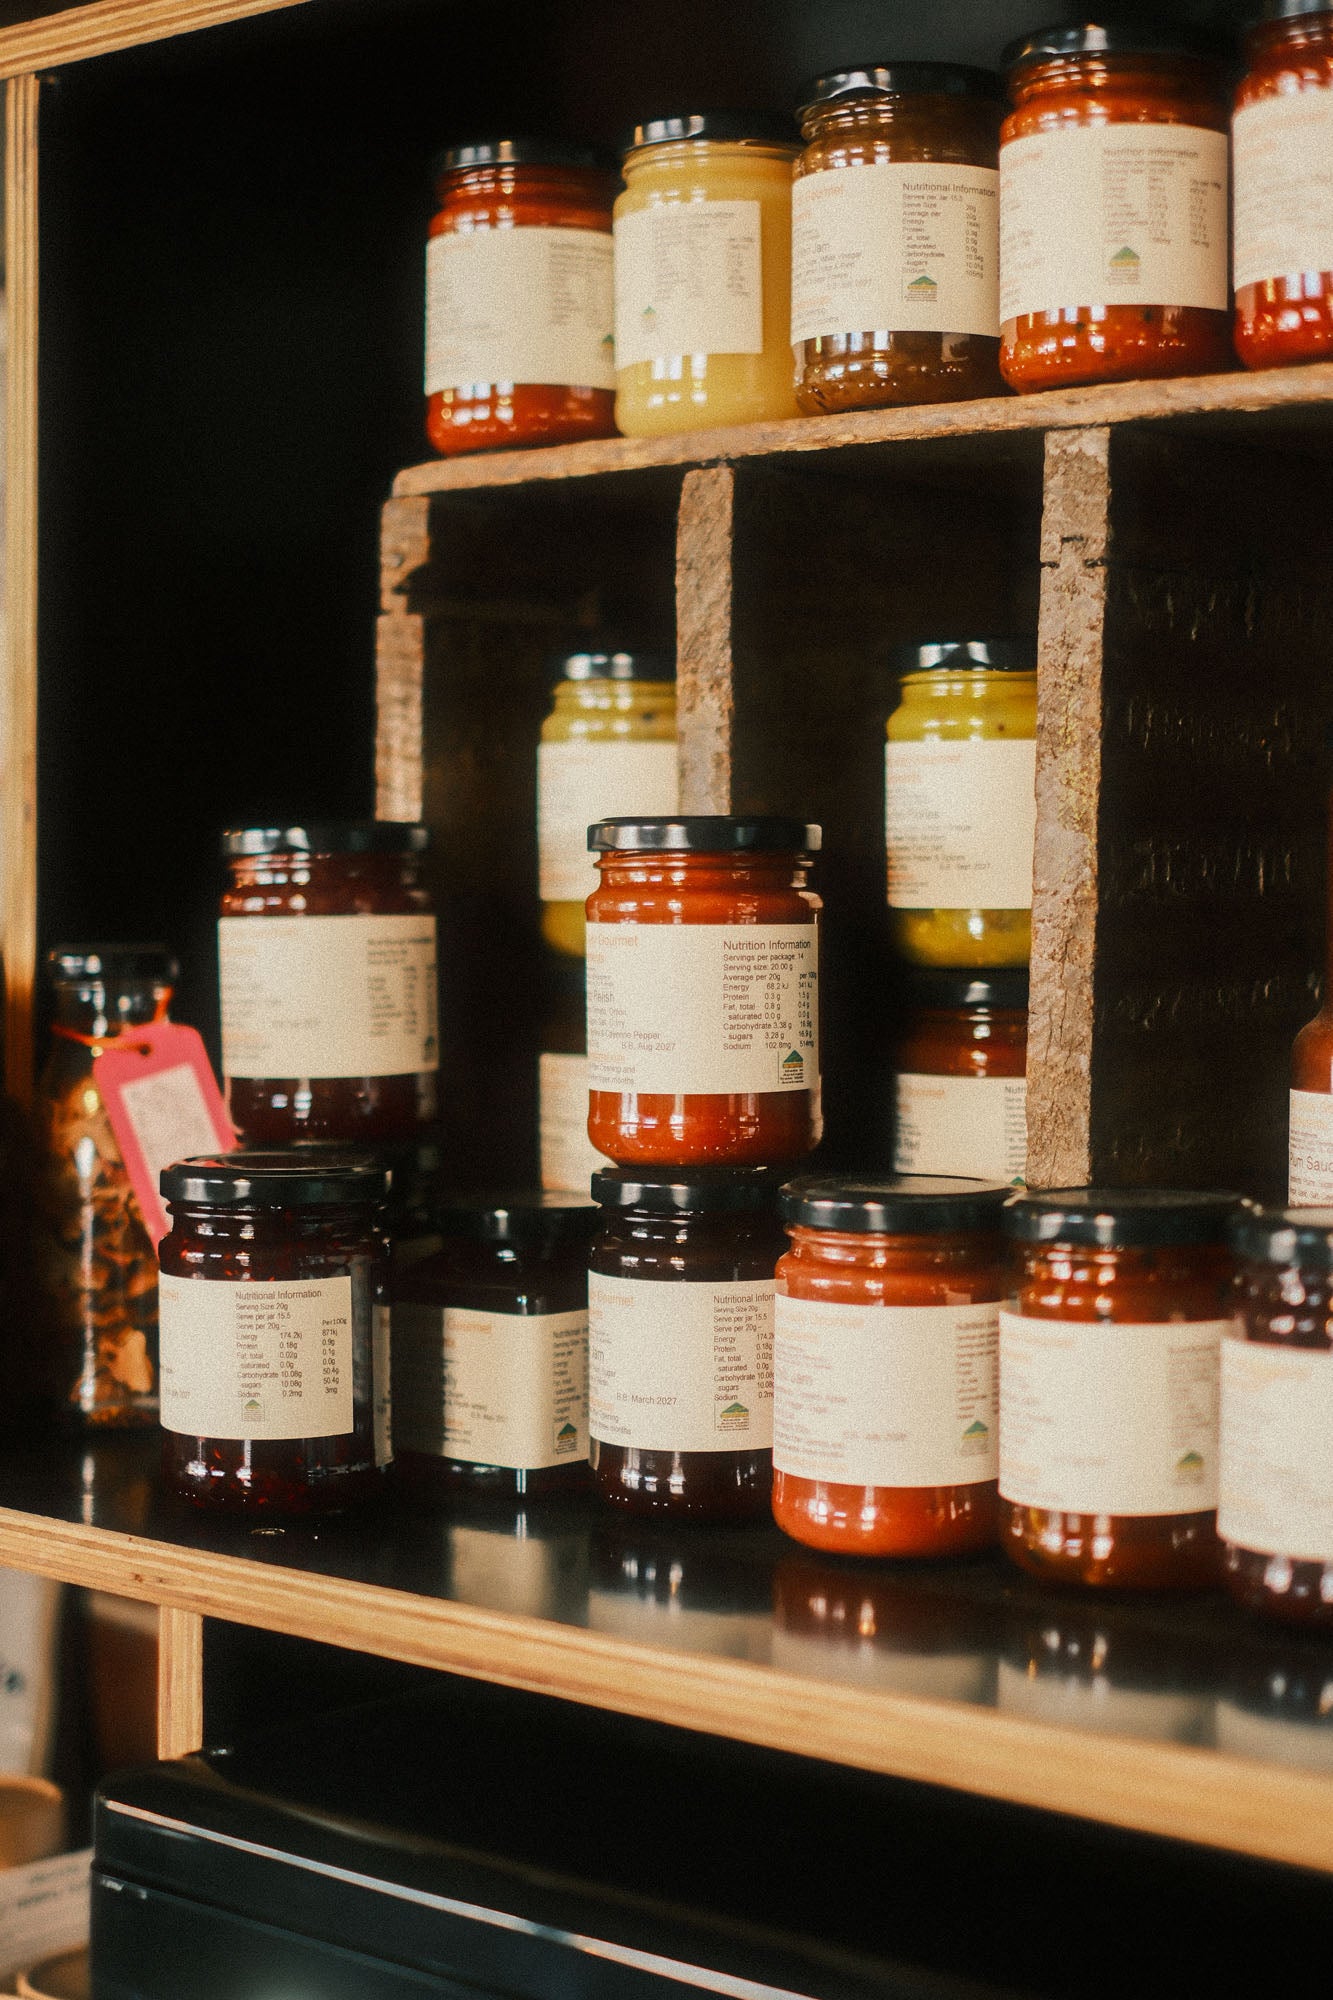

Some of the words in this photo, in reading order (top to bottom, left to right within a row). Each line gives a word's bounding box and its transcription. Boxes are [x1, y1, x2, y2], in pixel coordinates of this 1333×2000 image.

[902, 182, 950, 192] Nutritional
[952, 184, 996, 197] Information
[902, 251, 945, 259] Carbohydrate
[723, 940, 766, 951] Nutrition
[769, 939, 811, 950] Information
[723, 953, 755, 962] Servings
[757, 954, 768, 962] per
[723, 963, 751, 972] Serving
[770, 962, 788, 971] 20.00
[722, 974, 754, 982] Average
[756, 974, 768, 982] per
[768, 973, 781, 981] 20g
[723, 984, 750, 992] Energy
[723, 1003, 738, 1011] Fat,
[740, 1003, 756, 1011] total
[764, 1002, 775, 1010] 0.8
[728, 1012, 762, 1021] saturated
[764, 1012, 775, 1020] 0.0
[776, 1013, 781, 1021] g
[723, 1022, 772, 1032] Carbohydrate
[773, 1022, 787, 1030] 3.38
[788, 1023, 793, 1031] g
[633, 1030, 661, 1040] Pepper
[728, 1033, 753, 1041] sugars
[764, 1031, 779, 1040] 3.28
[639, 1043, 653, 1051] Aug
[655, 1042, 676, 1051] 2027
[723, 1042, 752, 1050] Sodium
[765, 1041, 792, 1050] 102.8mg
[235, 1290, 276, 1300] Nutritional
[278, 1289, 322, 1300] Information
[713, 1294, 753, 1304] Nutritional
[236, 1303, 259, 1312] Serving
[260, 1302, 275, 1310] Size
[276, 1302, 289, 1311] 20g
[748, 1305, 759, 1313] 20g
[255, 1313, 266, 1321] per
[277, 1312, 291, 1320] 15.5
[713, 1315, 732, 1323] Serve
[755, 1313, 768, 1321] 15.5
[236, 1322, 254, 1330] Serve
[255, 1322, 266, 1331] per
[268, 1321, 280, 1330] 20g
[713, 1325, 732, 1333] Serve
[733, 1325, 744, 1333] per
[745, 1324, 757, 1332] 20g
[236, 1333, 258, 1342] Energy
[713, 1335, 736, 1344] Energy
[279, 1341, 298, 1350] 0.18g
[321, 1338, 336, 1347] 0.9g
[713, 1345, 737, 1353] Protein
[756, 1343, 773, 1351] 0.18g
[279, 1351, 298, 1359] 0.02g
[727, 1354, 742, 1362] total
[756, 1352, 773, 1361] 0.02g
[241, 1362, 270, 1370] saturated
[279, 1361, 294, 1370] 0.0g
[322, 1357, 336, 1366] 0.0g
[718, 1364, 748, 1372] saturated
[756, 1362, 769, 1371] 0.0g
[237, 1371, 279, 1380] Carbohydrate
[281, 1370, 303, 1379] 10.08g
[322, 1366, 340, 1375] 50.4g
[713, 1373, 756, 1383] Carbohydrate
[241, 1381, 262, 1389] sugars
[281, 1380, 303, 1389] 10.08g
[323, 1376, 340, 1385] 50.4g
[282, 1389, 303, 1398] 0.2mg
[324, 1386, 338, 1395] 3mg
[718, 1384, 740, 1392] sugars
[631, 1395, 655, 1405] March
[656, 1396, 677, 1406] 2027
[714, 1393, 738, 1401] Sodium
